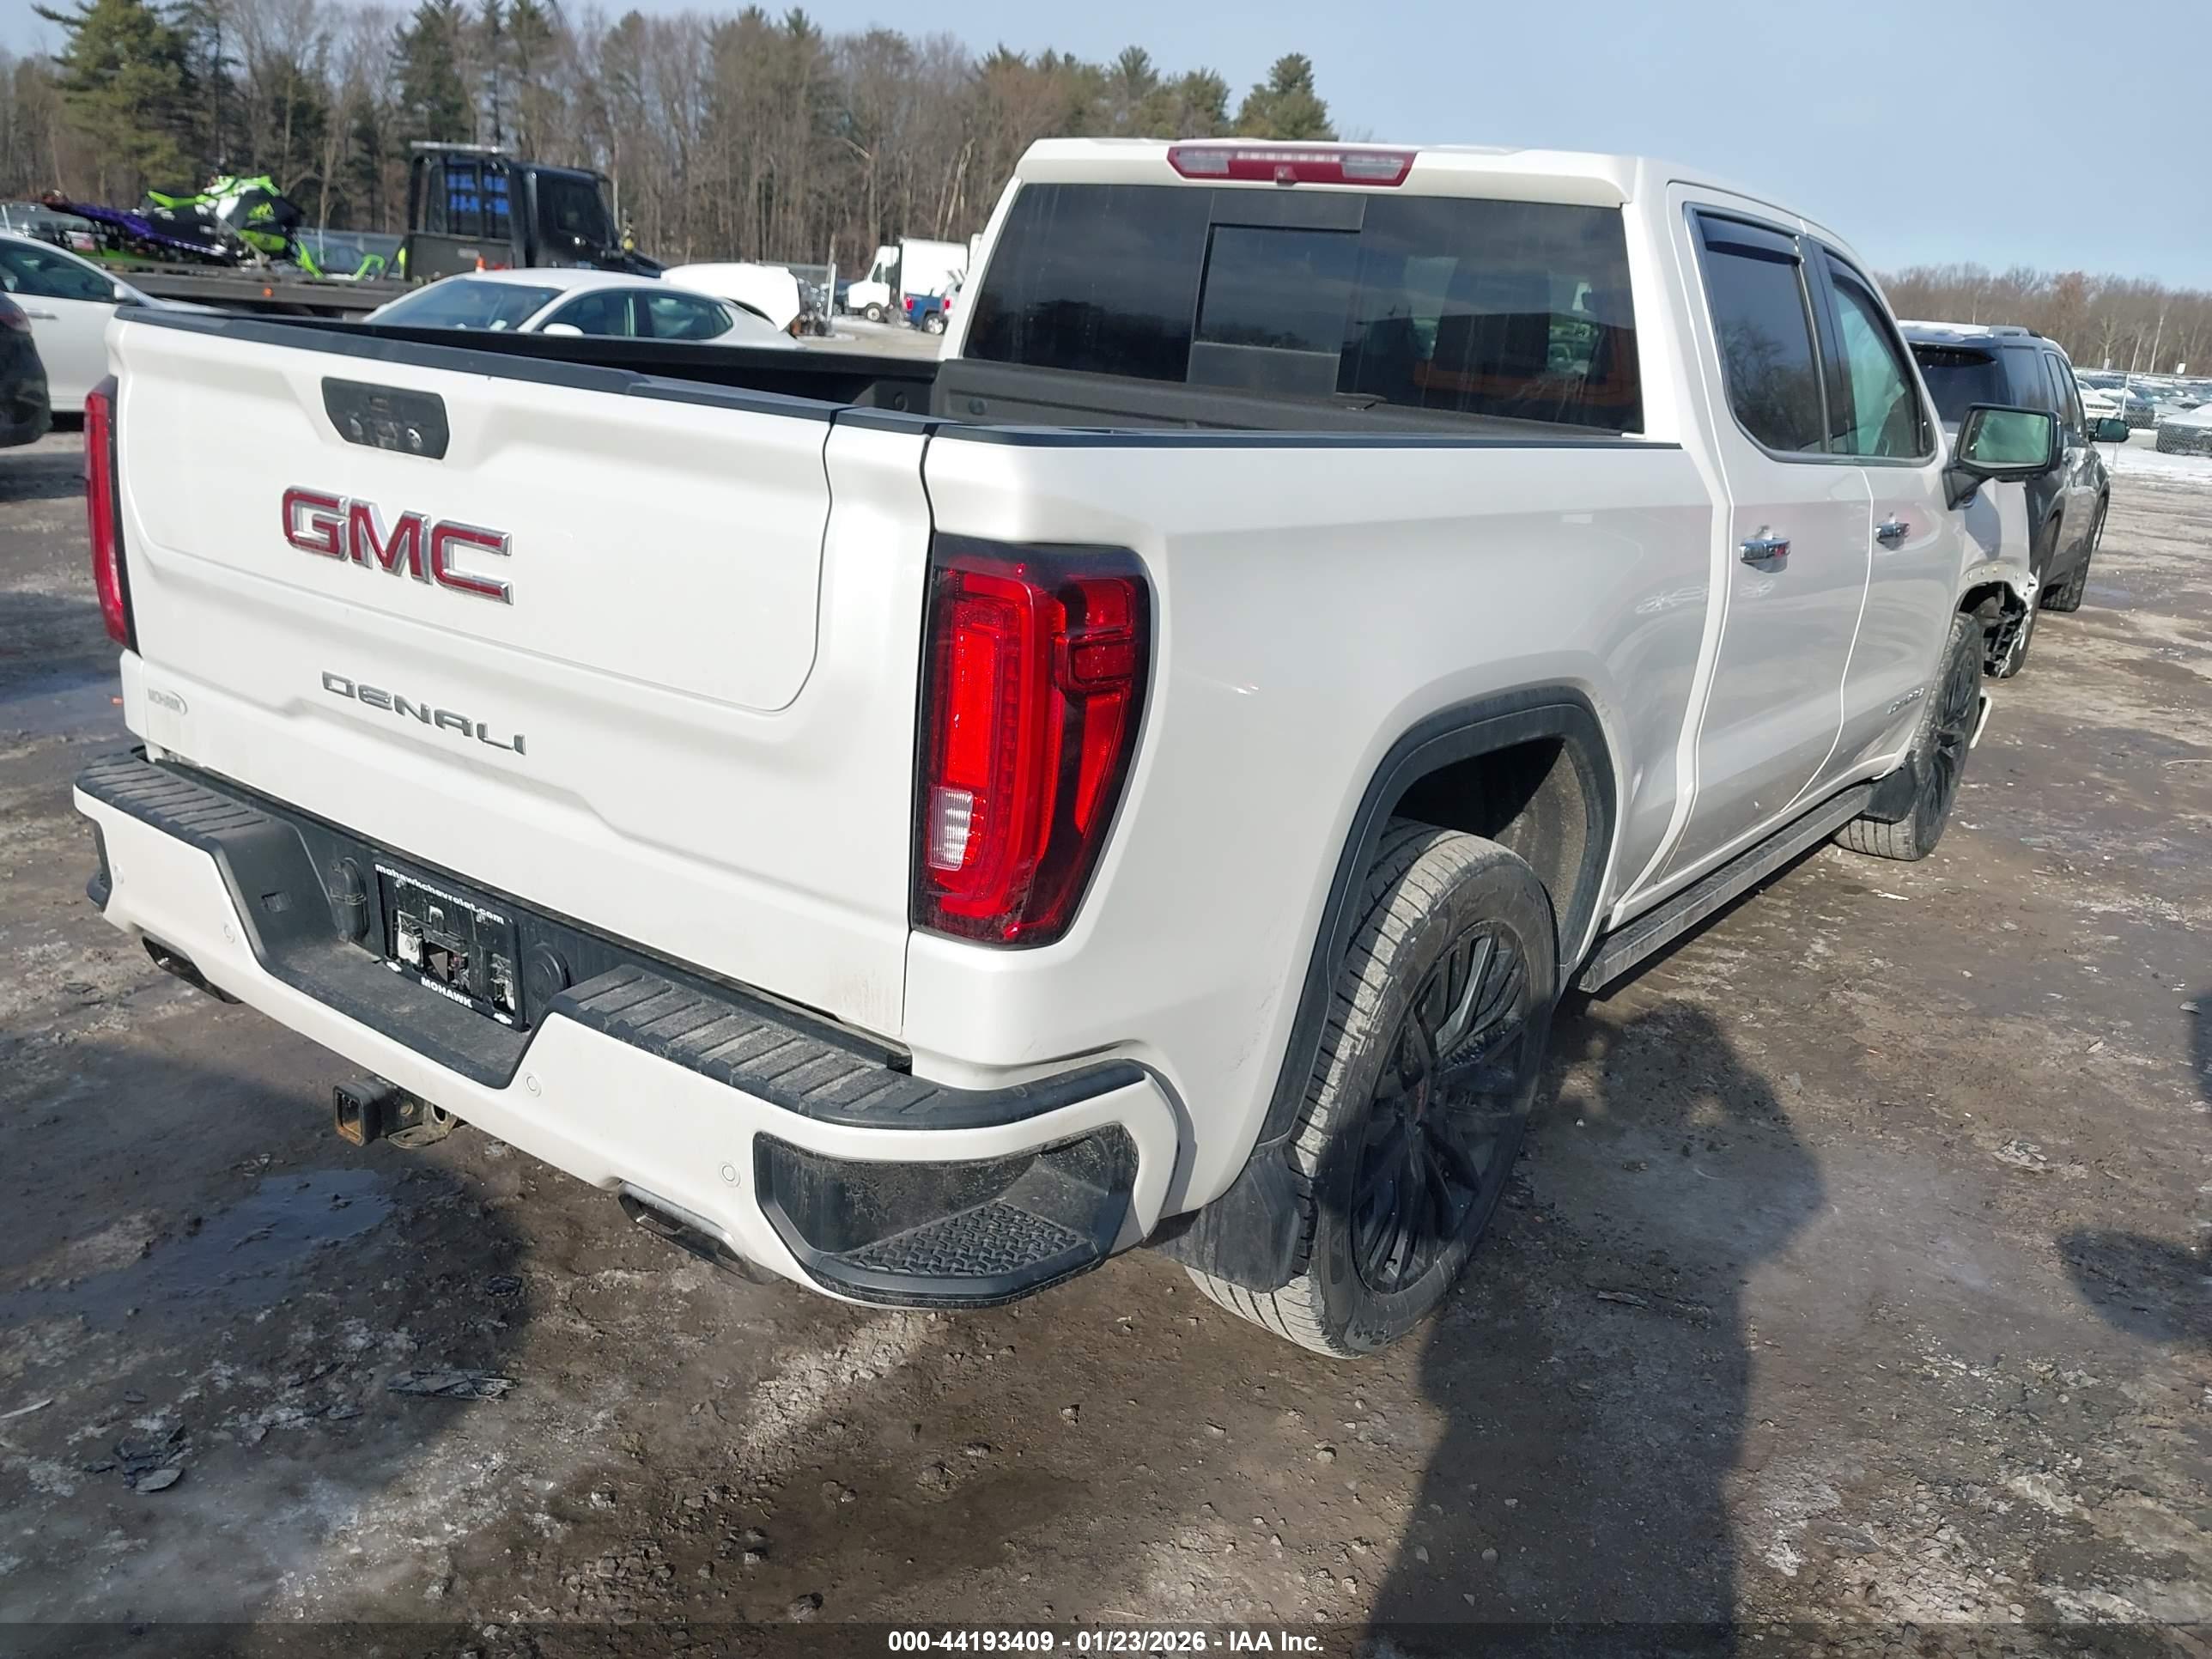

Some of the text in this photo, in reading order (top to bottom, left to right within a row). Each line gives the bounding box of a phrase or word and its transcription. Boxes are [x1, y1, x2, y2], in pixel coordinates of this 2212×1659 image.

[282, 485, 514, 605] GMC
[321, 671, 527, 755] DENALI
[374, 863, 505, 925] mohawkchevrolet.com
[421, 975, 472, 1008] MOHAWK
